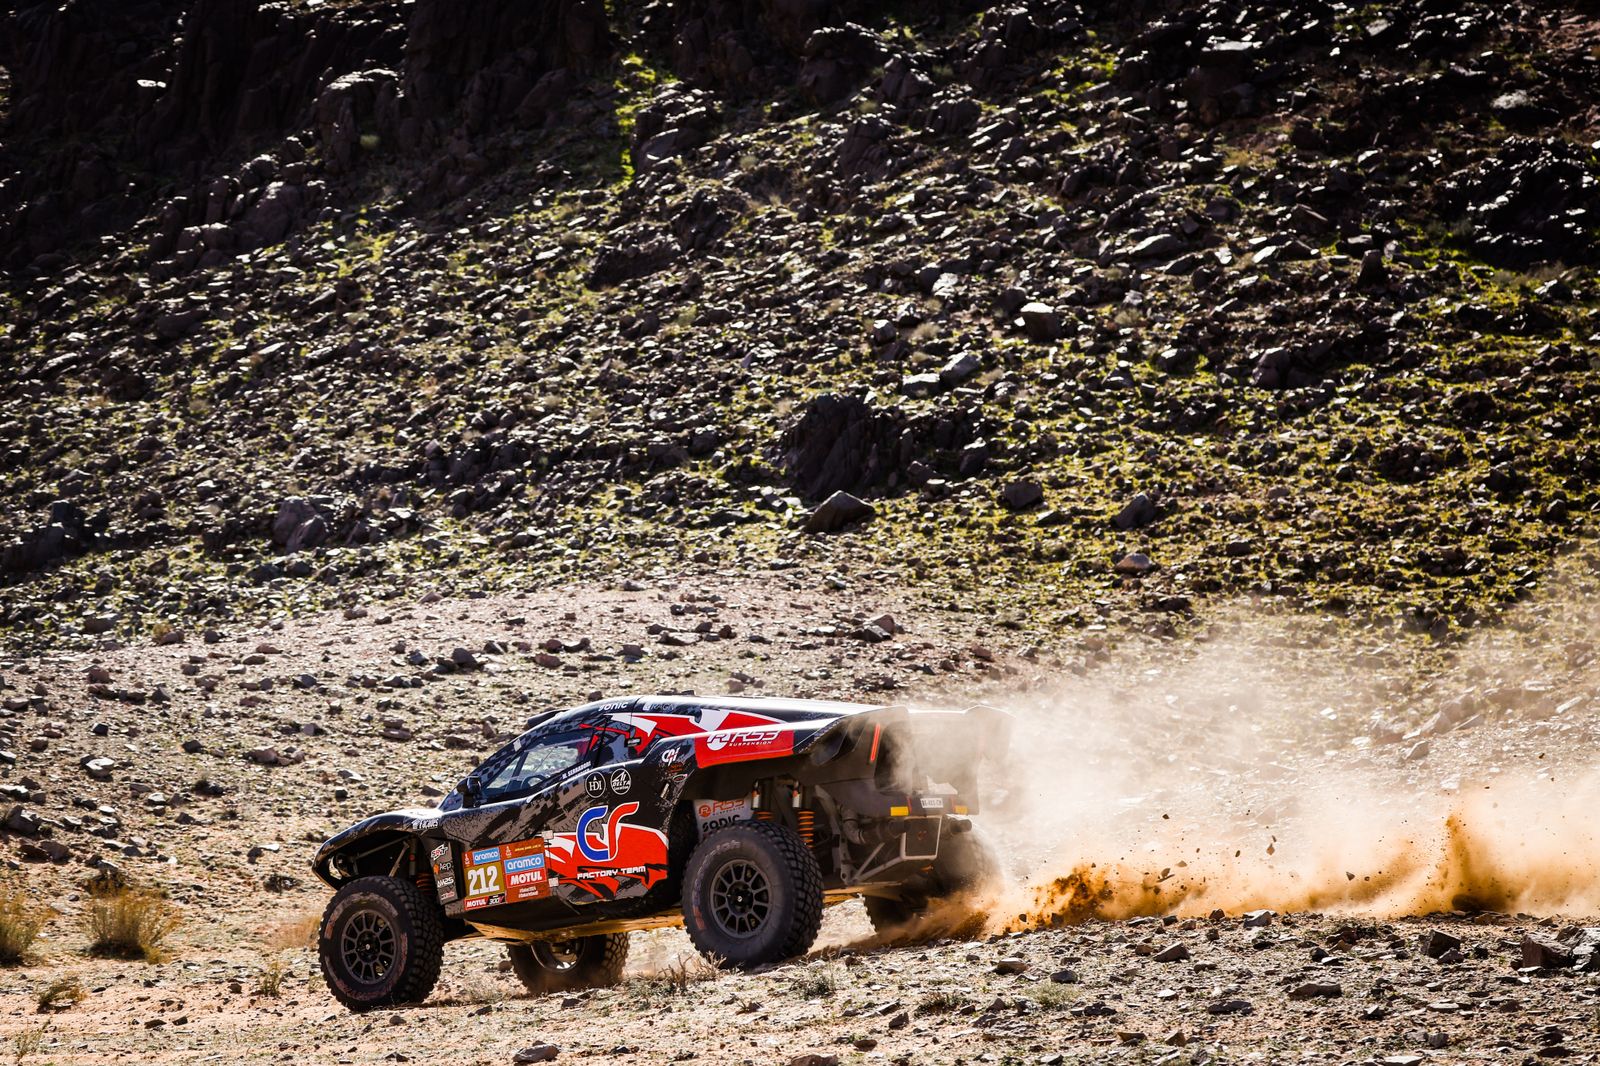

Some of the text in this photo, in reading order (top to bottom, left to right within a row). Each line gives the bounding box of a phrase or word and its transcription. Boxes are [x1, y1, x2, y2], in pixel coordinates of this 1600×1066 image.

[589, 780, 602, 791] HDI
[613, 779, 630, 787] DELTA
[473, 851, 499, 861] aramco
[507, 857, 542, 870] aramco
[510, 871, 543, 885] MOTUL
[577, 866, 647, 880] FACTORY TEAM
[467, 865, 500, 896] 212
[467, 899, 487, 908] MOTUL
